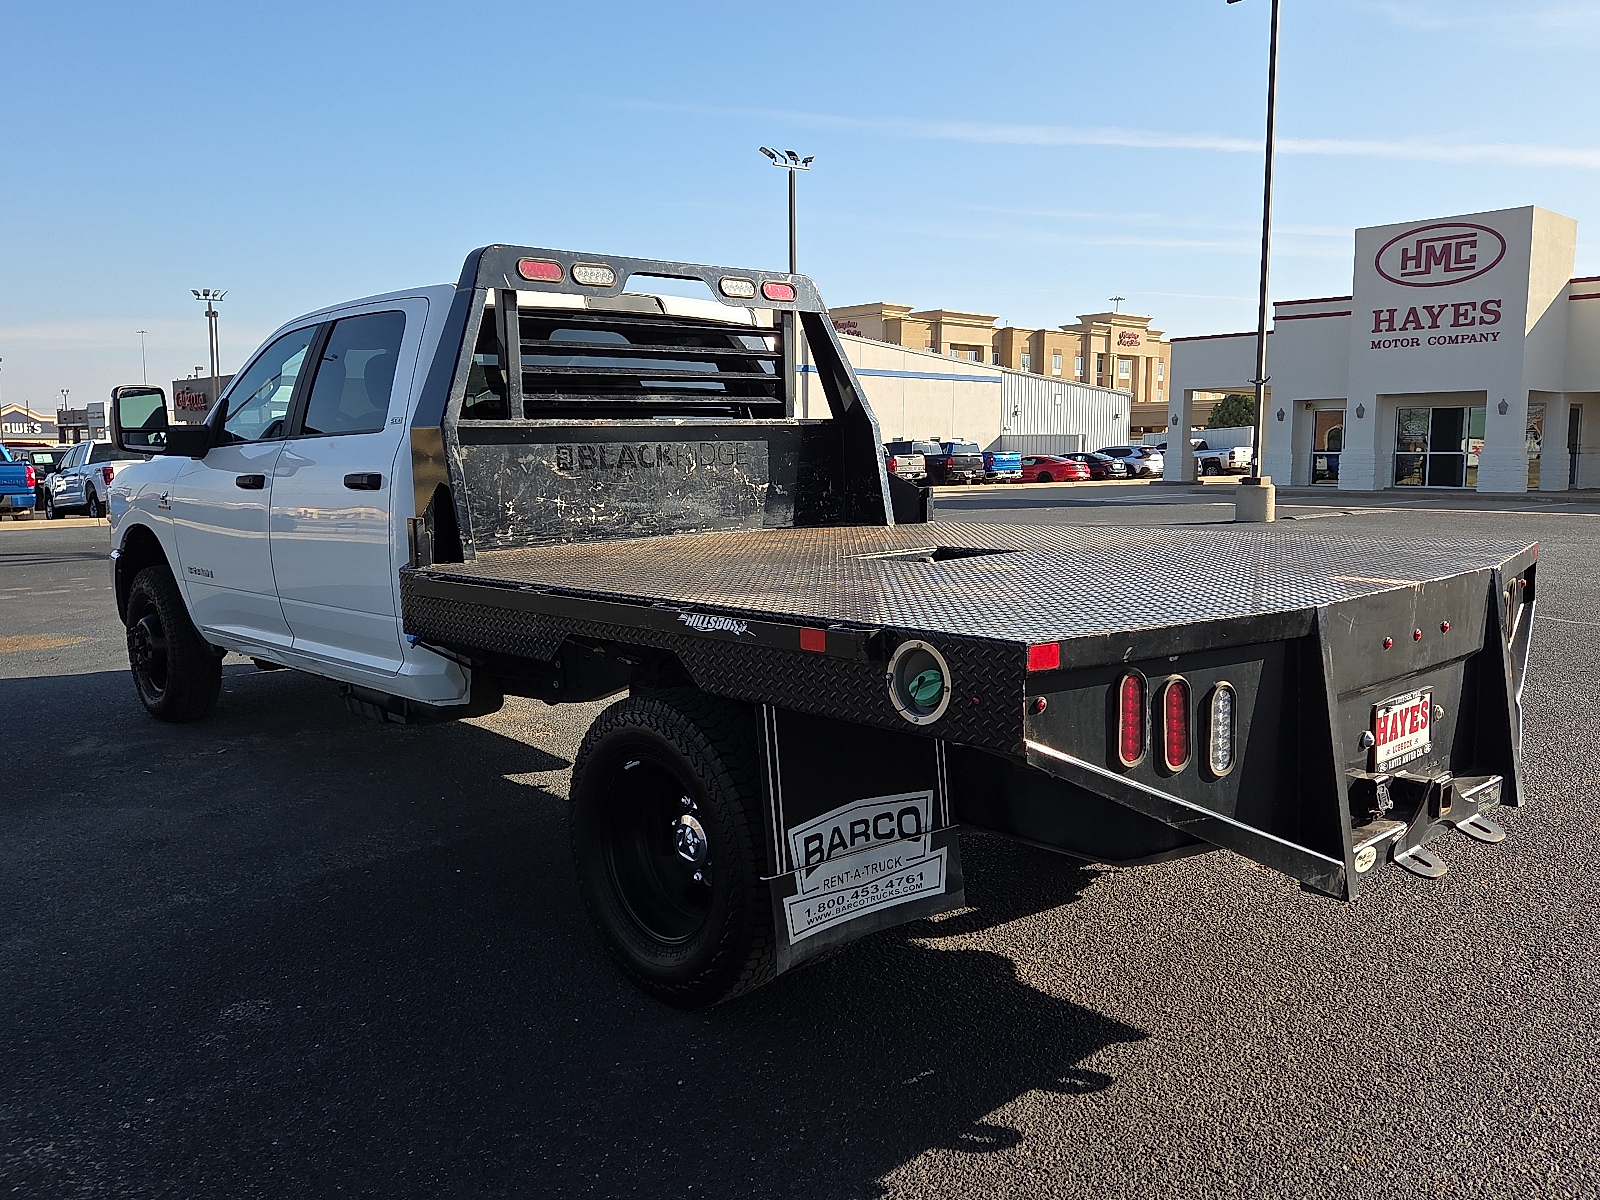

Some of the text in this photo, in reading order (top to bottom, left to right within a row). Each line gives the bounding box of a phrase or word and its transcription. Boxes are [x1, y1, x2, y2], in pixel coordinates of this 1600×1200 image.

[1401, 232, 1477, 277] HMC
[1371, 299, 1502, 334] HAYES
[1370, 332, 1501, 350] MOTOR COMPANY
[577, 442, 749, 471] BLACKRIDGE
[1376, 700, 1429, 747] HAYES
[803, 806, 922, 879] BARCO
[823, 855, 902, 891] RENT-A-TRUCK
[804, 872, 924, 918] 1.800.453.4761
[806, 883, 924, 926] WWW.BARCOTRUCKS.COM
